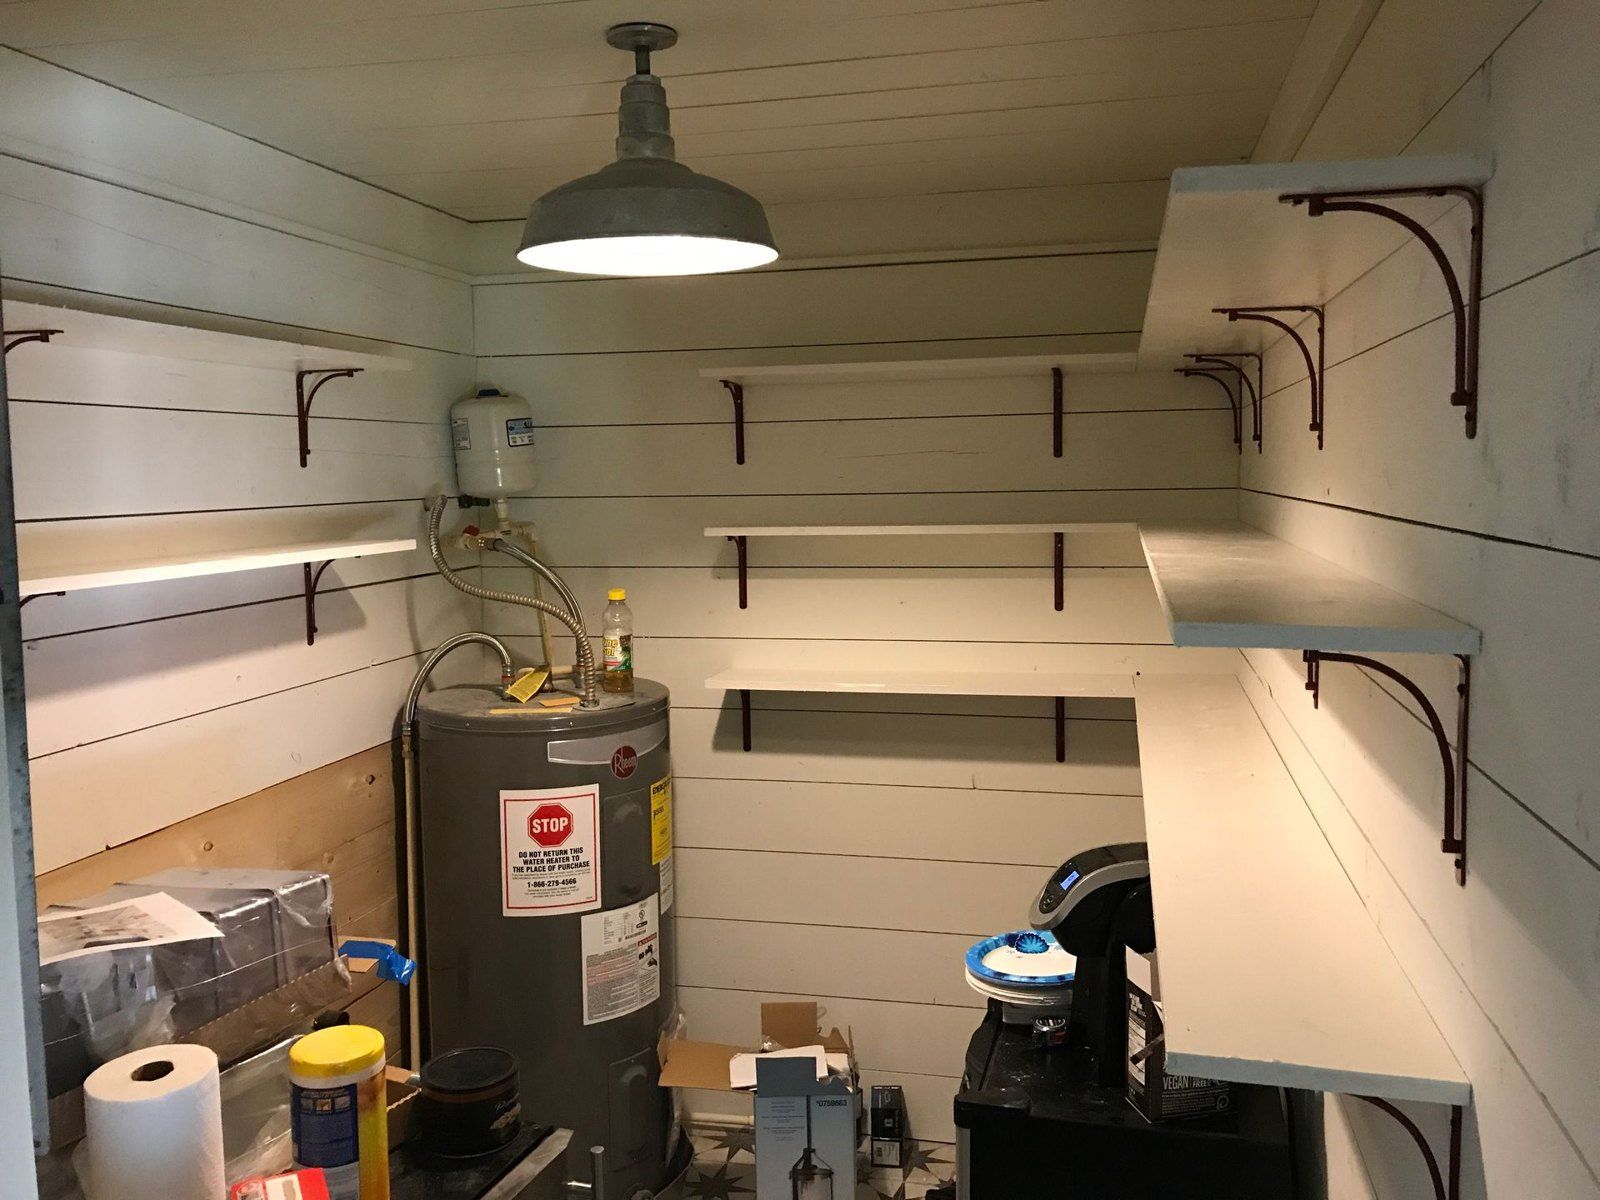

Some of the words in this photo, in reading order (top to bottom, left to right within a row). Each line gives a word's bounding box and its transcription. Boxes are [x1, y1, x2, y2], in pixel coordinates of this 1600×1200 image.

[532, 817, 569, 834] STOP
[543, 849, 568, 857] RETURN
[570, 847, 583, 855] THIS
[546, 856, 570, 864] HEATER
[526, 865, 546, 873] PLACE
[558, 861, 590, 871] PURCHASE
[1163, 1075, 1188, 1090] VEGAN
